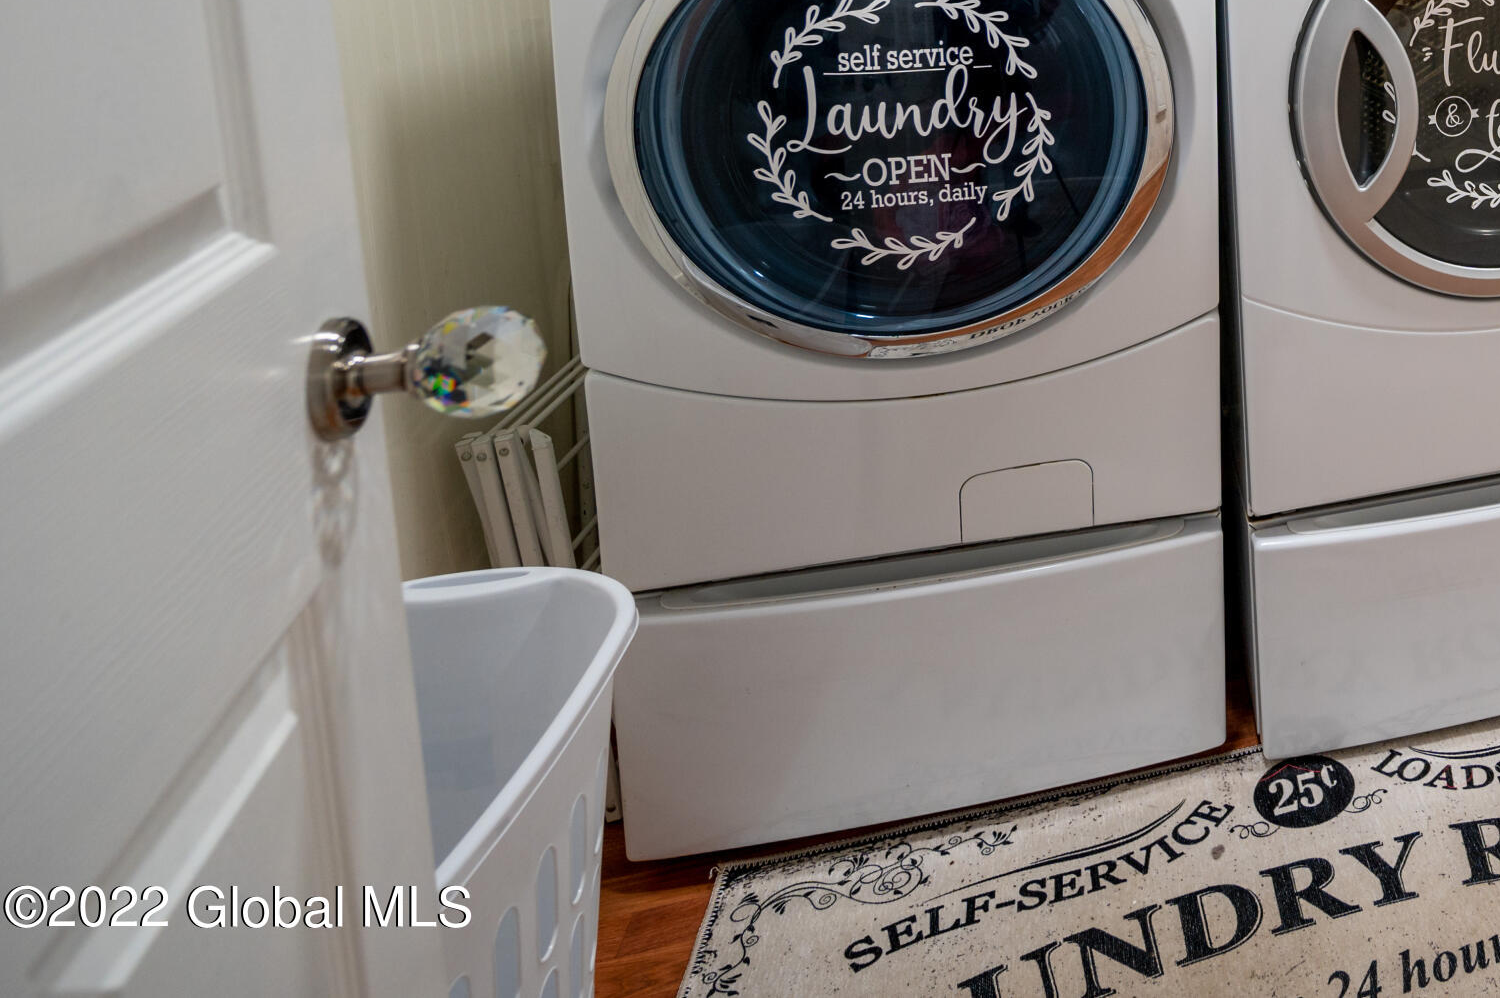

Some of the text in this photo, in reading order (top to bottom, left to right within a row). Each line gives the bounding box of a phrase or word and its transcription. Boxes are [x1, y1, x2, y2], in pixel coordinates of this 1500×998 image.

[838, 40, 974, 72] self service
[786, 64, 1028, 164] Laundry
[862, 152, 952, 187] OPEN
[841, 182, 988, 210] 24 hours, daily
[1267, 762, 1338, 817] 25¢
[843, 799, 1235, 974] SELF-SERVICE
[1327, 959, 1383, 998] 24
